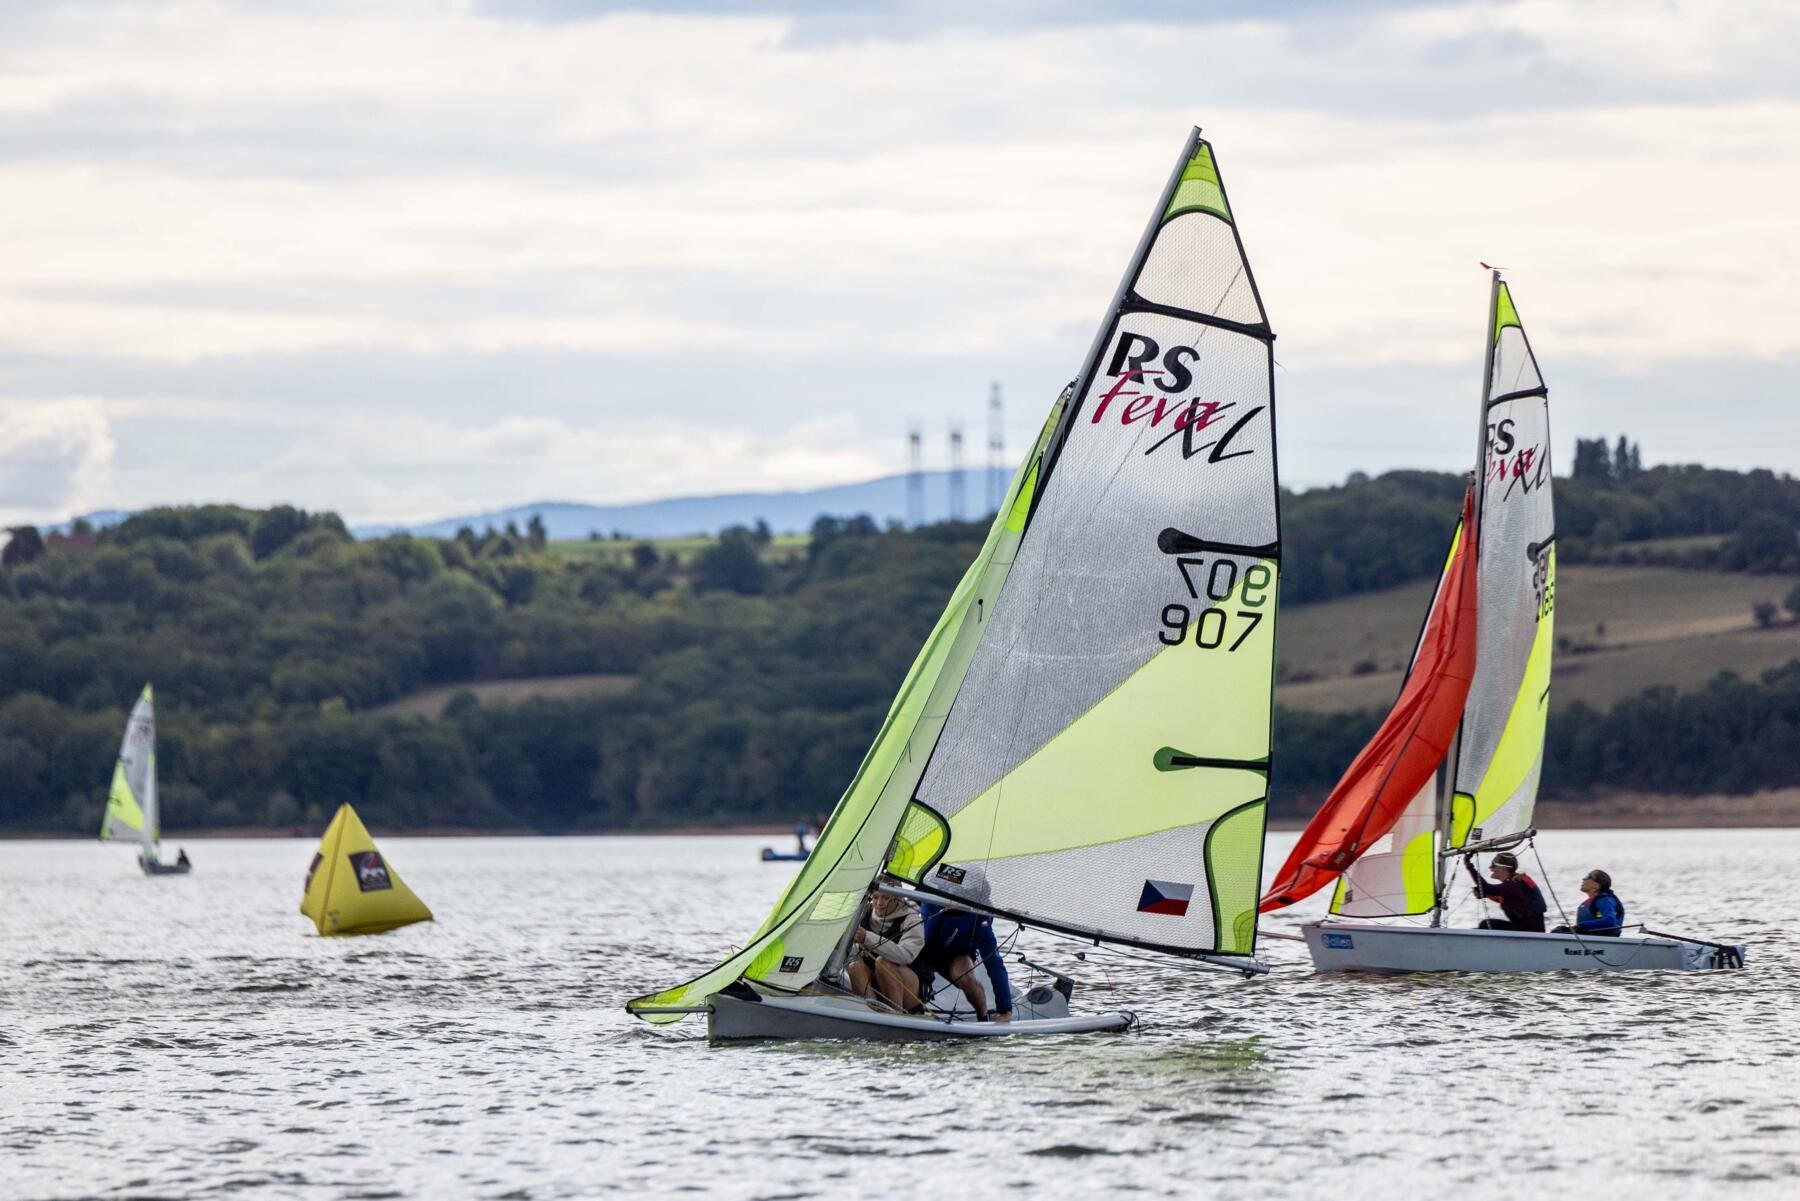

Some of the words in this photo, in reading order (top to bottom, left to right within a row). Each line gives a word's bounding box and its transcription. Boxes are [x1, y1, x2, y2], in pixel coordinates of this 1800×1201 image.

[1106, 331, 1200, 394] RS
[1091, 369, 1225, 432] Feva
[1144, 396, 1266, 464] XL
[1158, 603, 1263, 652] 907
[942, 866, 964, 877] RS
[785, 957, 802, 967] RS
